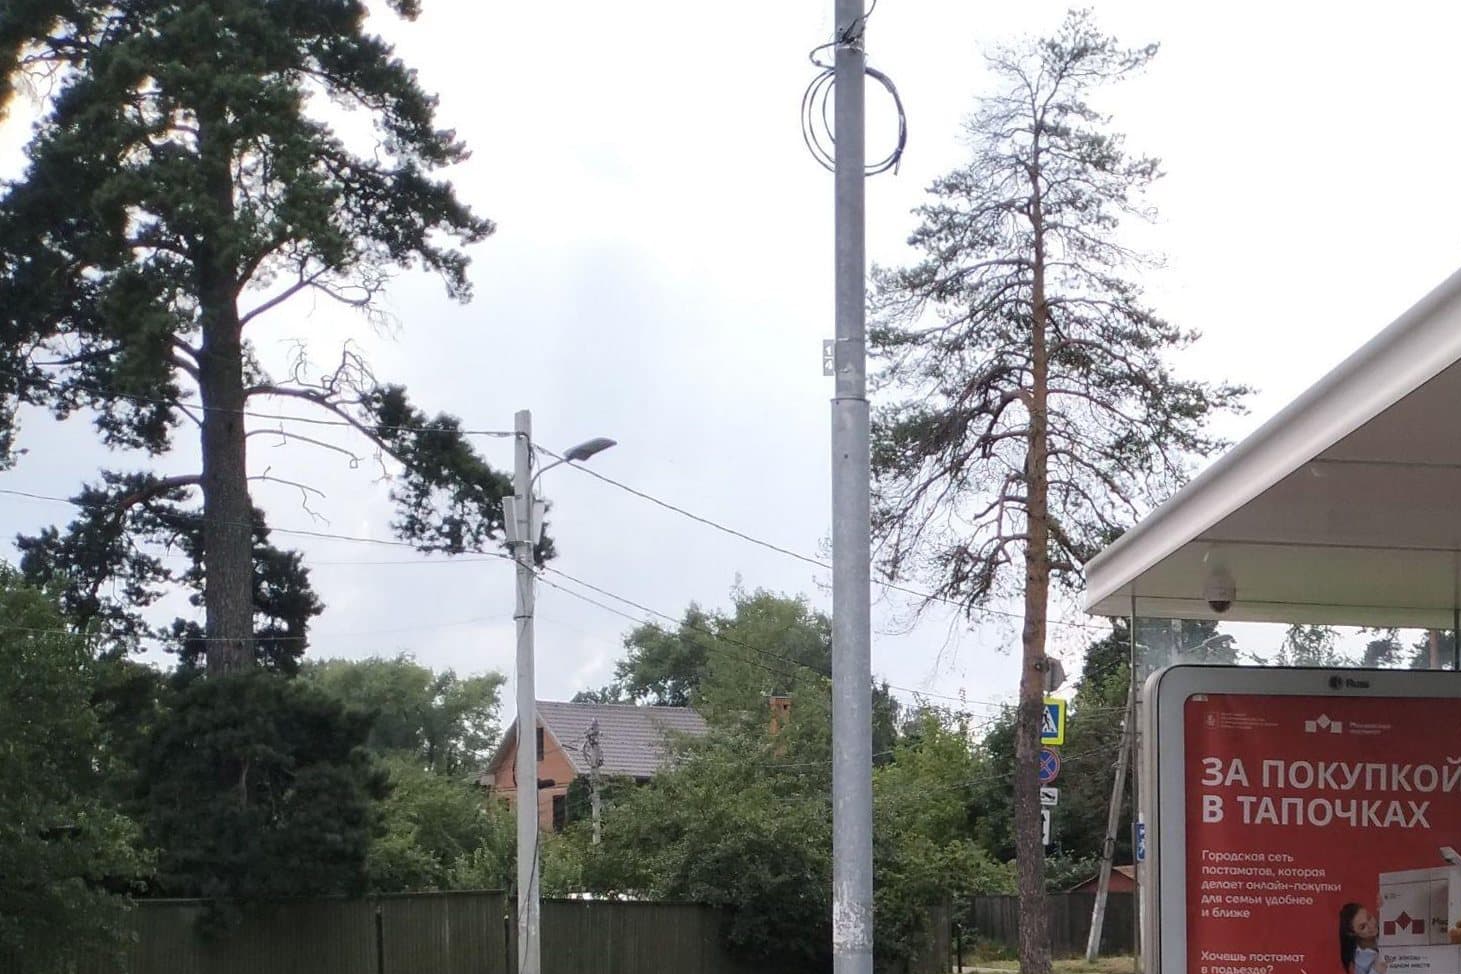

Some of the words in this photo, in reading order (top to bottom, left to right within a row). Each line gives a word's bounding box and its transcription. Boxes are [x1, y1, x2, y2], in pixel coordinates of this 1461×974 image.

[1202, 757, 1249, 787] ЗА
[1202, 795, 1224, 823] В
[1237, 796, 1431, 829] ТАПОЧКАХ
[1202, 850, 1265, 862] Городская
[1268, 853, 1294, 862] сеть
[1202, 866, 1276, 877] постаматов,
[1278, 867, 1326, 877] которая
[1201, 881, 1242, 890] делает
[1246, 881, 1342, 893] онлайн-покупки
[1201, 895, 1222, 904] для
[1225, 895, 1262, 904] семьи
[1265, 895, 1314, 907] удобнее
[1201, 908, 1209, 917] и
[1212, 907, 1251, 918] ближе
[1201, 951, 1246, 961] Хочешь
[1249, 953, 1305, 963] постамат
